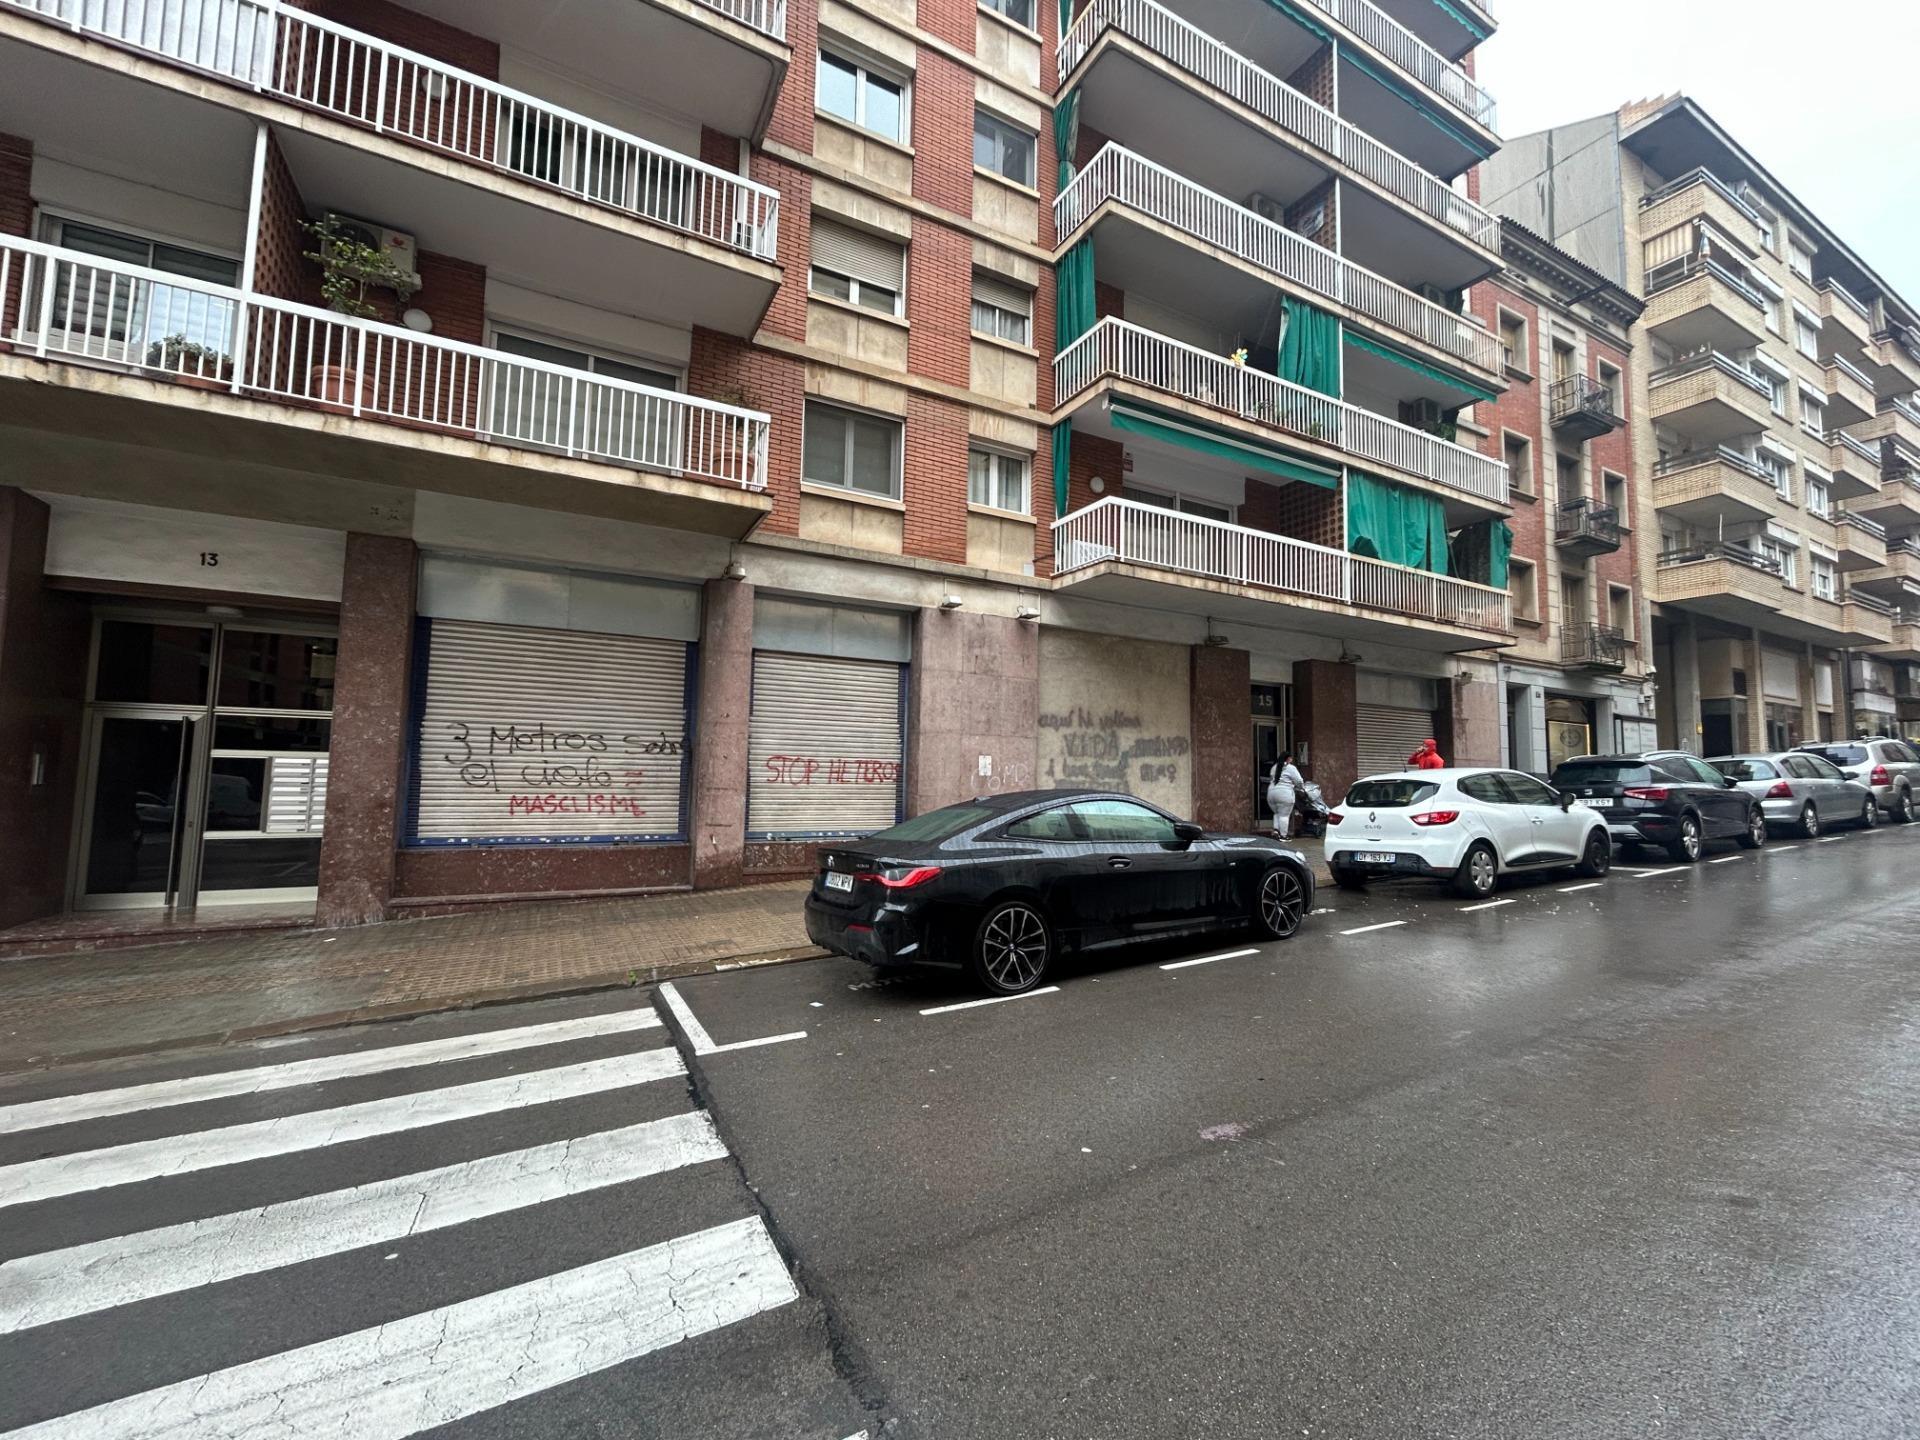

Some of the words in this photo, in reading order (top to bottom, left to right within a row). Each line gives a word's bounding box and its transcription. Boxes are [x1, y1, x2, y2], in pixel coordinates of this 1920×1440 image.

[200, 552, 218, 566] 13
[1259, 695, 1272, 706] 15
[445, 723, 472, 764] 3
[490, 722, 608, 754] Metros
[461, 759, 500, 792] el
[766, 755, 819, 785] STOP
[508, 793, 646, 816] MASCLISME
